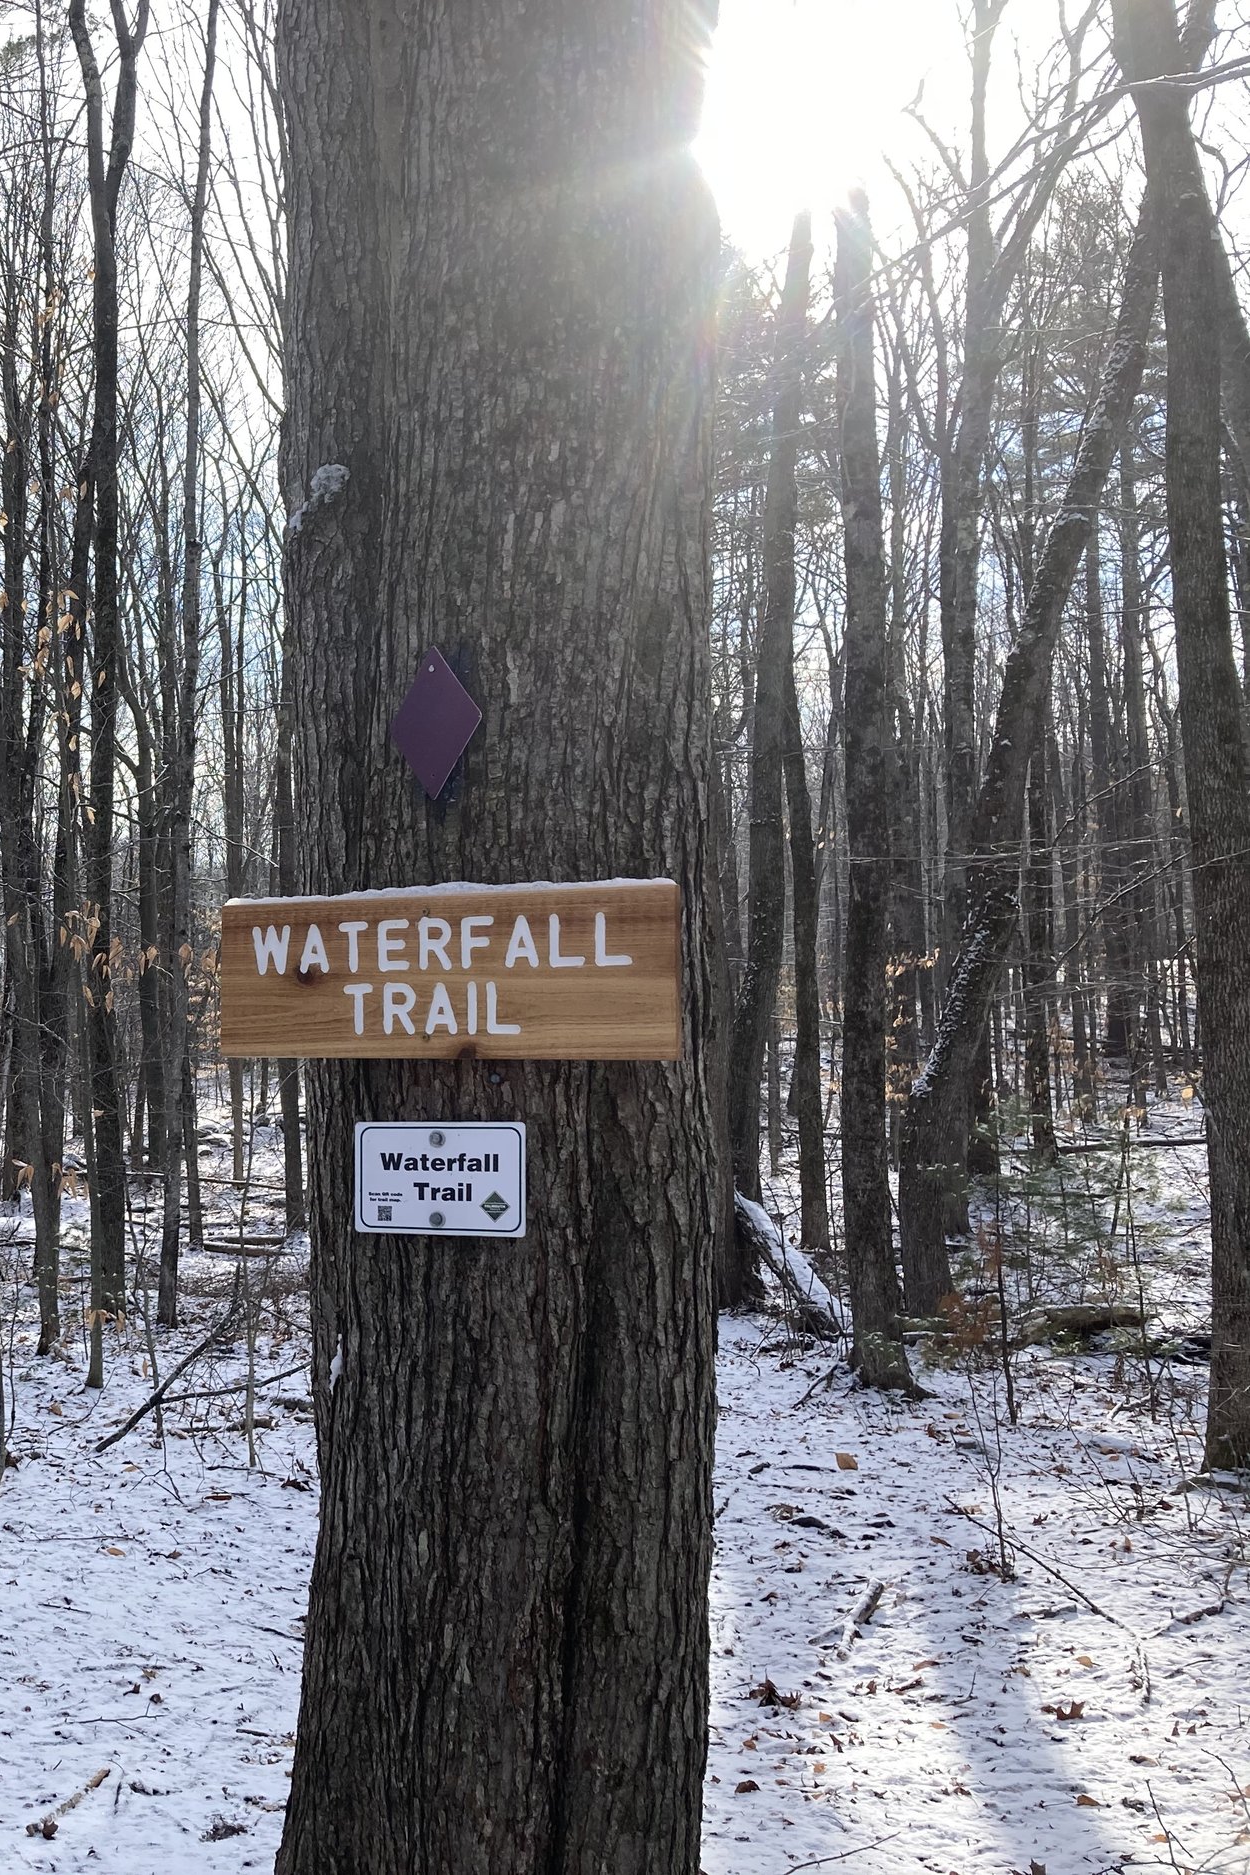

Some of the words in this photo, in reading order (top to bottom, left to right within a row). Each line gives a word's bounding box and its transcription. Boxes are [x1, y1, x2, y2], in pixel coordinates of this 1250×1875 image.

[252, 911, 633, 976] WATERFALL
[343, 981, 521, 1036] TRAIL
[380, 1152, 499, 1172] Waterfall
[413, 1182, 472, 1202] Trail
